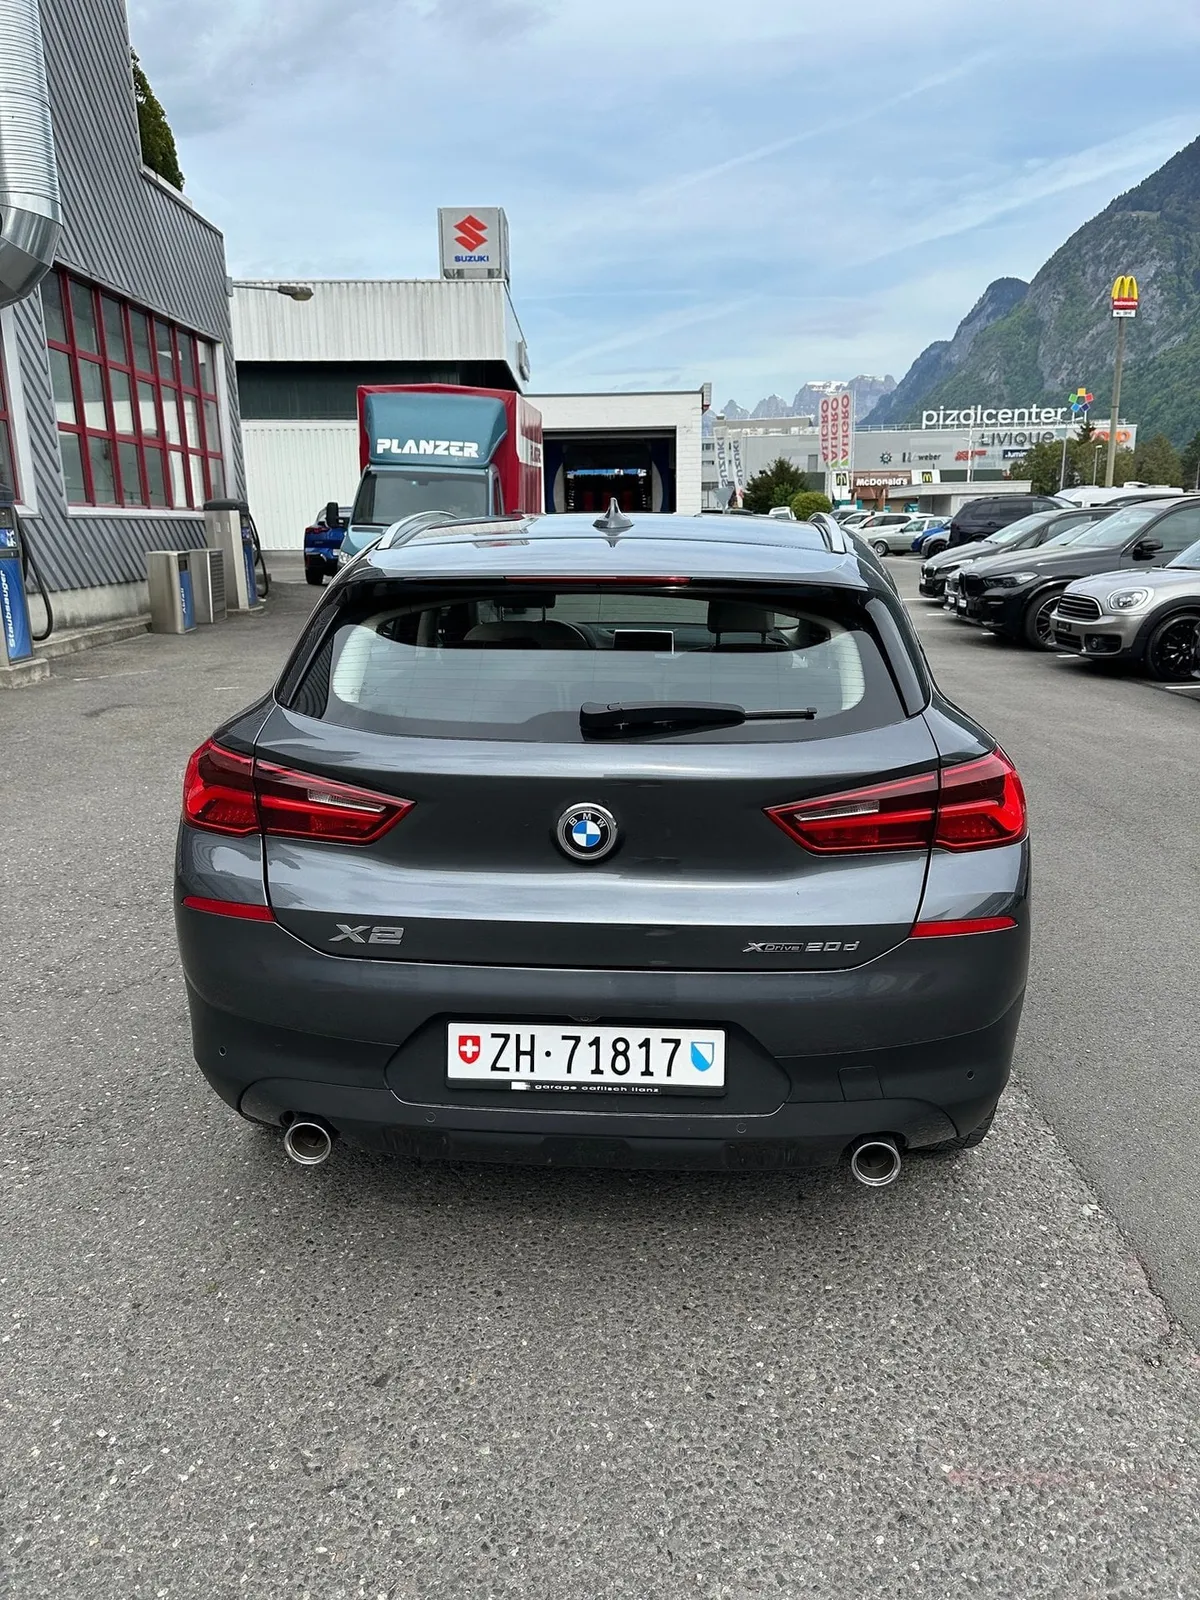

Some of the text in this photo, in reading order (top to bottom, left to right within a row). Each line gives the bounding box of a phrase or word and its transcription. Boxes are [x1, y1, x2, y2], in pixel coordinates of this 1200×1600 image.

[454, 255, 490, 263] SUZUKI
[921, 404, 1067, 430] pizolcenter
[376, 438, 480, 458] PLANZER
[917, 452, 941, 462] weber
[856, 477, 908, 487] McDonald's
[0, 570, 15, 648] Staubsauger
[568, 812, 606, 828] BMW
[328, 924, 404, 945] X2
[534, 1083, 578, 1091] garage
